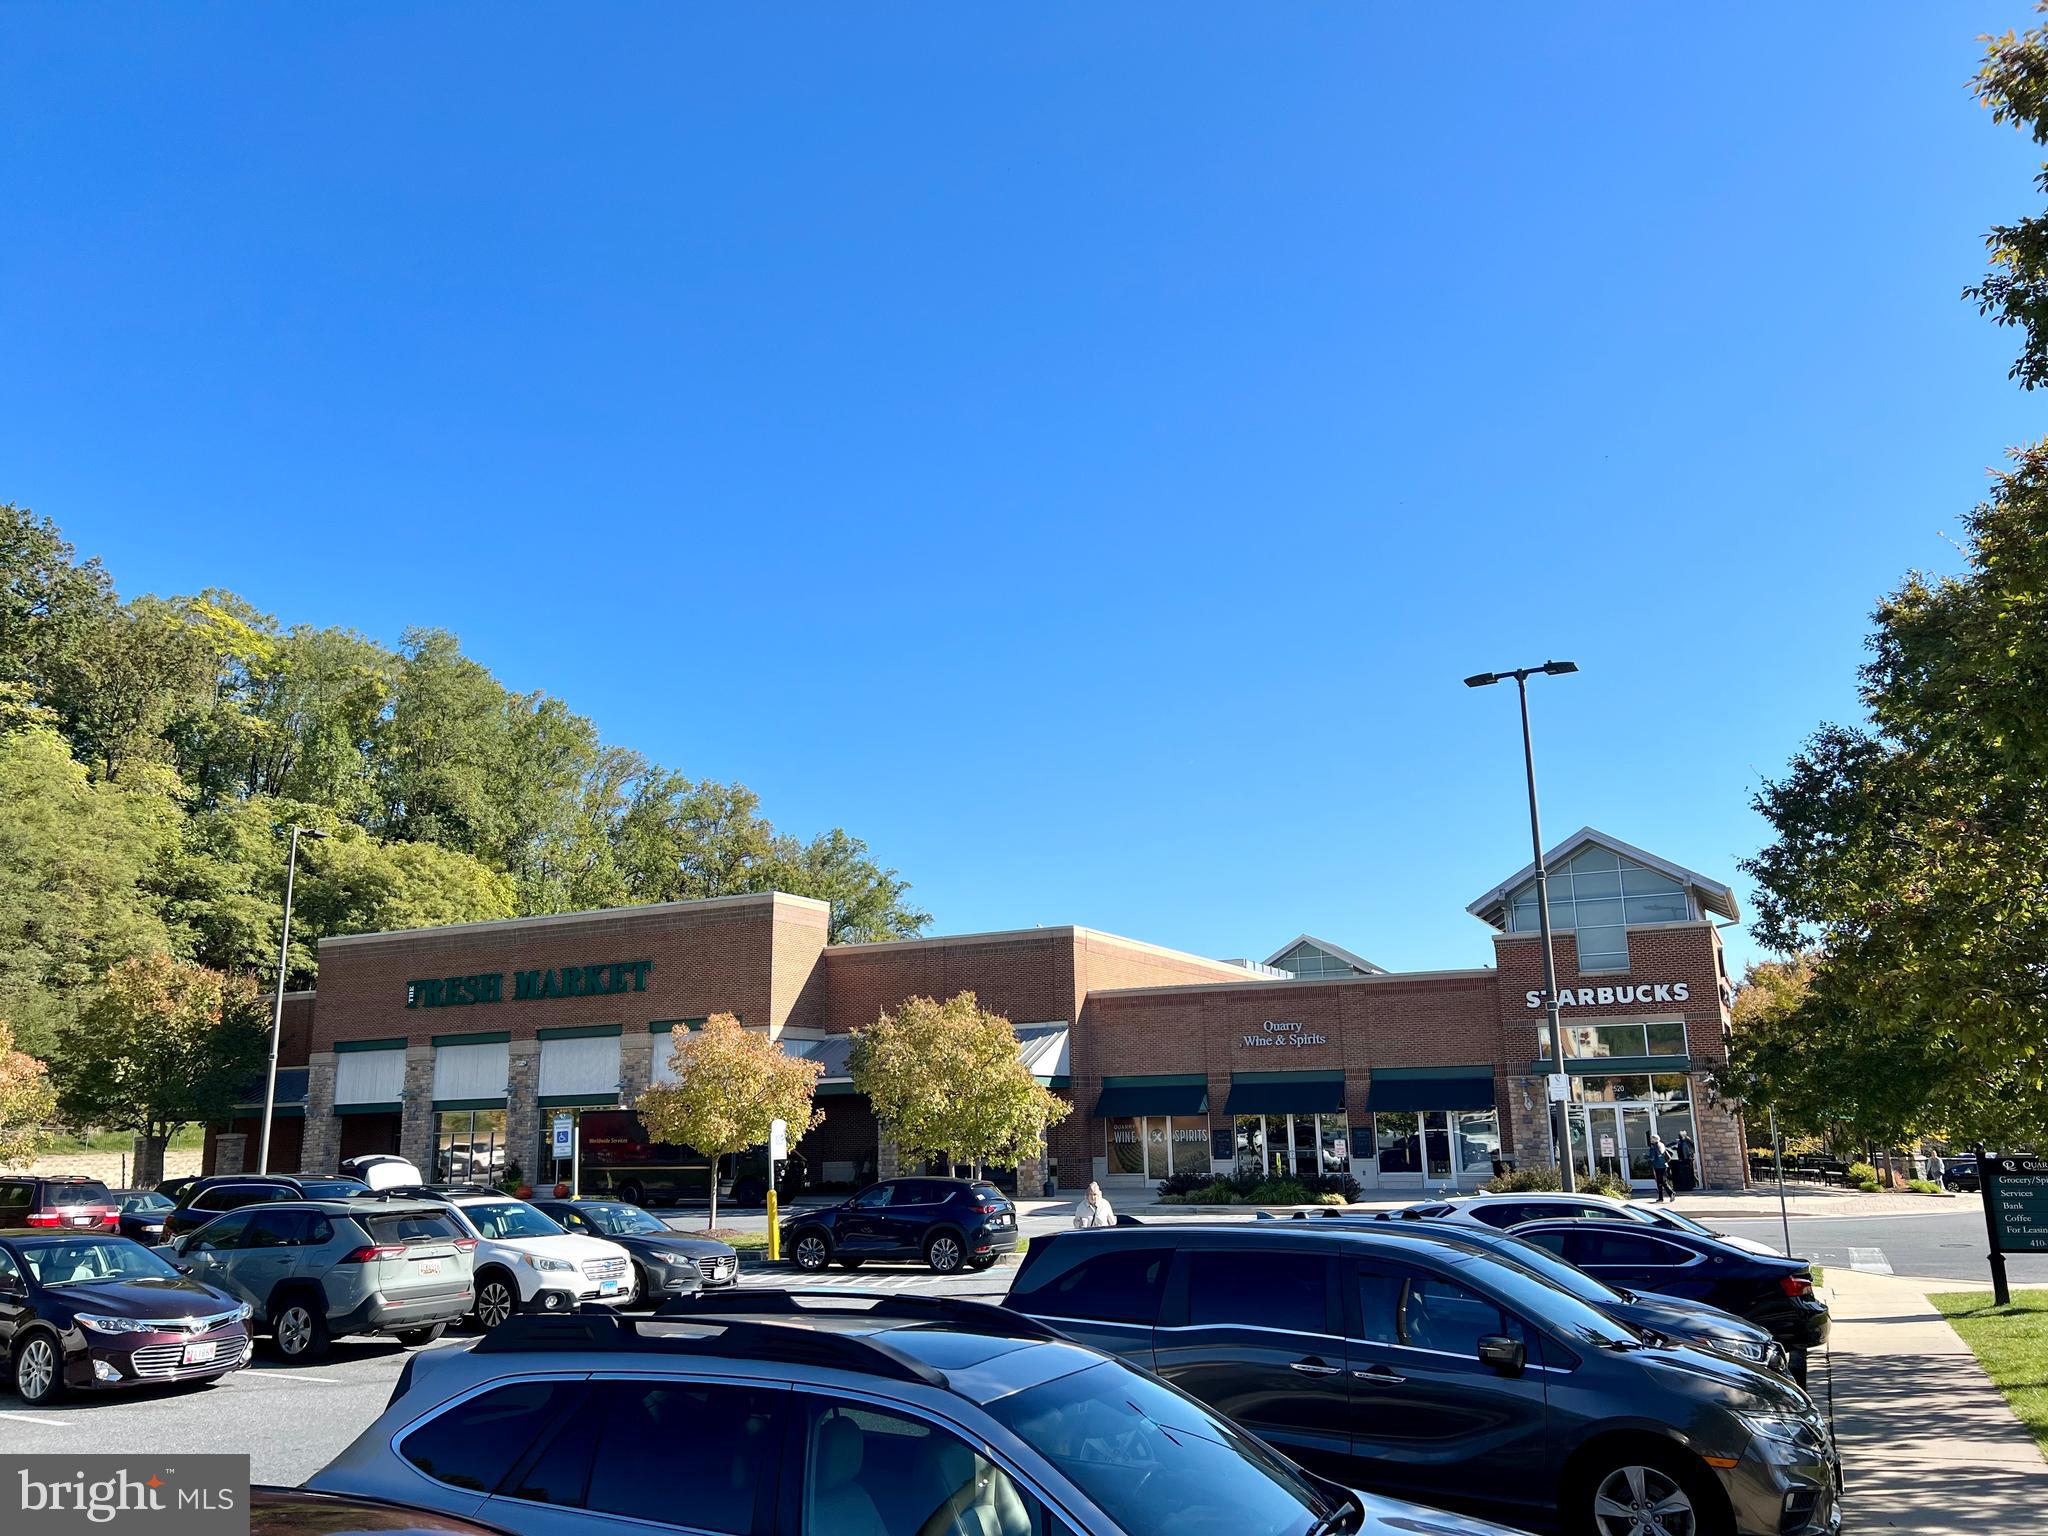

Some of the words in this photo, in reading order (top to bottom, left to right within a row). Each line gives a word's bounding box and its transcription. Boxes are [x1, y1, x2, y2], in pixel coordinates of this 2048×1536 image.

[406, 973, 503, 1008] FRESH
[513, 960, 655, 1000] MARKET
[1526, 983, 1690, 1008] SARBUCKS
[1263, 1020, 1302, 1033] Quarry
[1243, 1035, 1273, 1047] Wine
[1275, 1034, 1287, 1046] &
[1289, 1033, 1326, 1048] Spirits
[1114, 1131, 1137, 1143] WINE
[1174, 1129, 1208, 1142] SPIRITS
[2000, 1189, 2033, 1197] Services
[2003, 1202, 2024, 1210] Bank
[2004, 1214, 2032, 1222] Coffee
[2006, 1225, 2021, 1233] For
